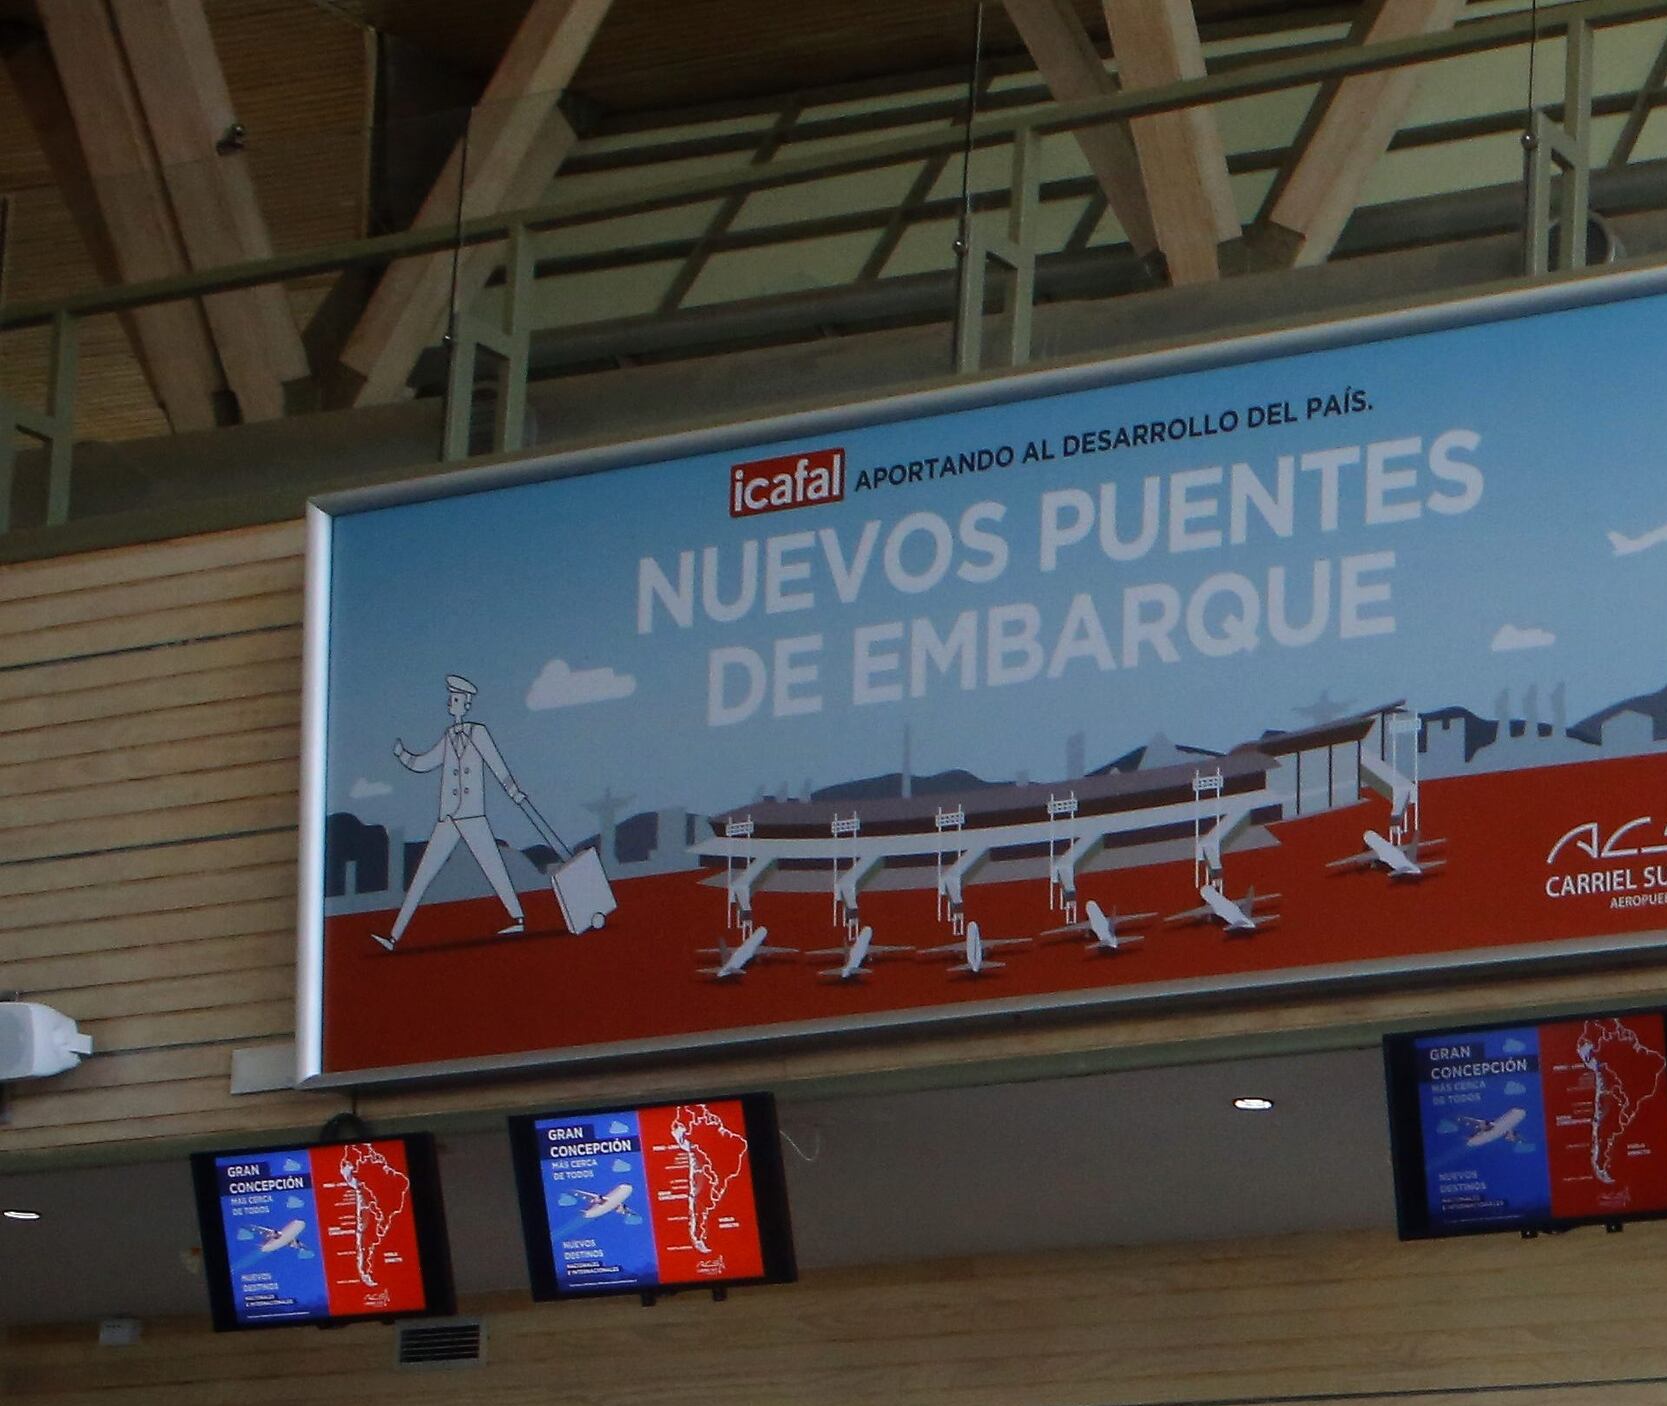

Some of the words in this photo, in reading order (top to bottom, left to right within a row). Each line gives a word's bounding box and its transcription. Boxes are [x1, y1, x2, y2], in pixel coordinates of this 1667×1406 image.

[854, 446, 1015, 493] APORTANDO
[1023, 440, 1056, 461] AL
[1063, 410, 1239, 459] DESARROLLO
[1247, 402, 1299, 428] DEL
[1306, 387, 1374, 419] PAÍS.
[733, 454, 841, 513] icafal
[637, 499, 1010, 635] NUEVOS
[1041, 427, 1485, 572] PUENTES
[707, 634, 823, 728] DE
[853, 550, 1399, 706] EMBARQUE
[1546, 868, 1637, 897] CARRIEL
[1429, 1045, 1471, 1061] GRAN
[1431, 1056, 1528, 1080] CONCEPCIÓN
[548, 1127, 584, 1141] GRAN
[550, 1138, 632, 1158] CONCEPCIÓN
[227, 1164, 260, 1178] GRAN
[570, 1158, 598, 1169] CERCA
[229, 1176, 304, 1194] CONCEPCIÓN
[553, 1171, 567, 1181] DE
[567, 1170, 595, 1180] TODOS
